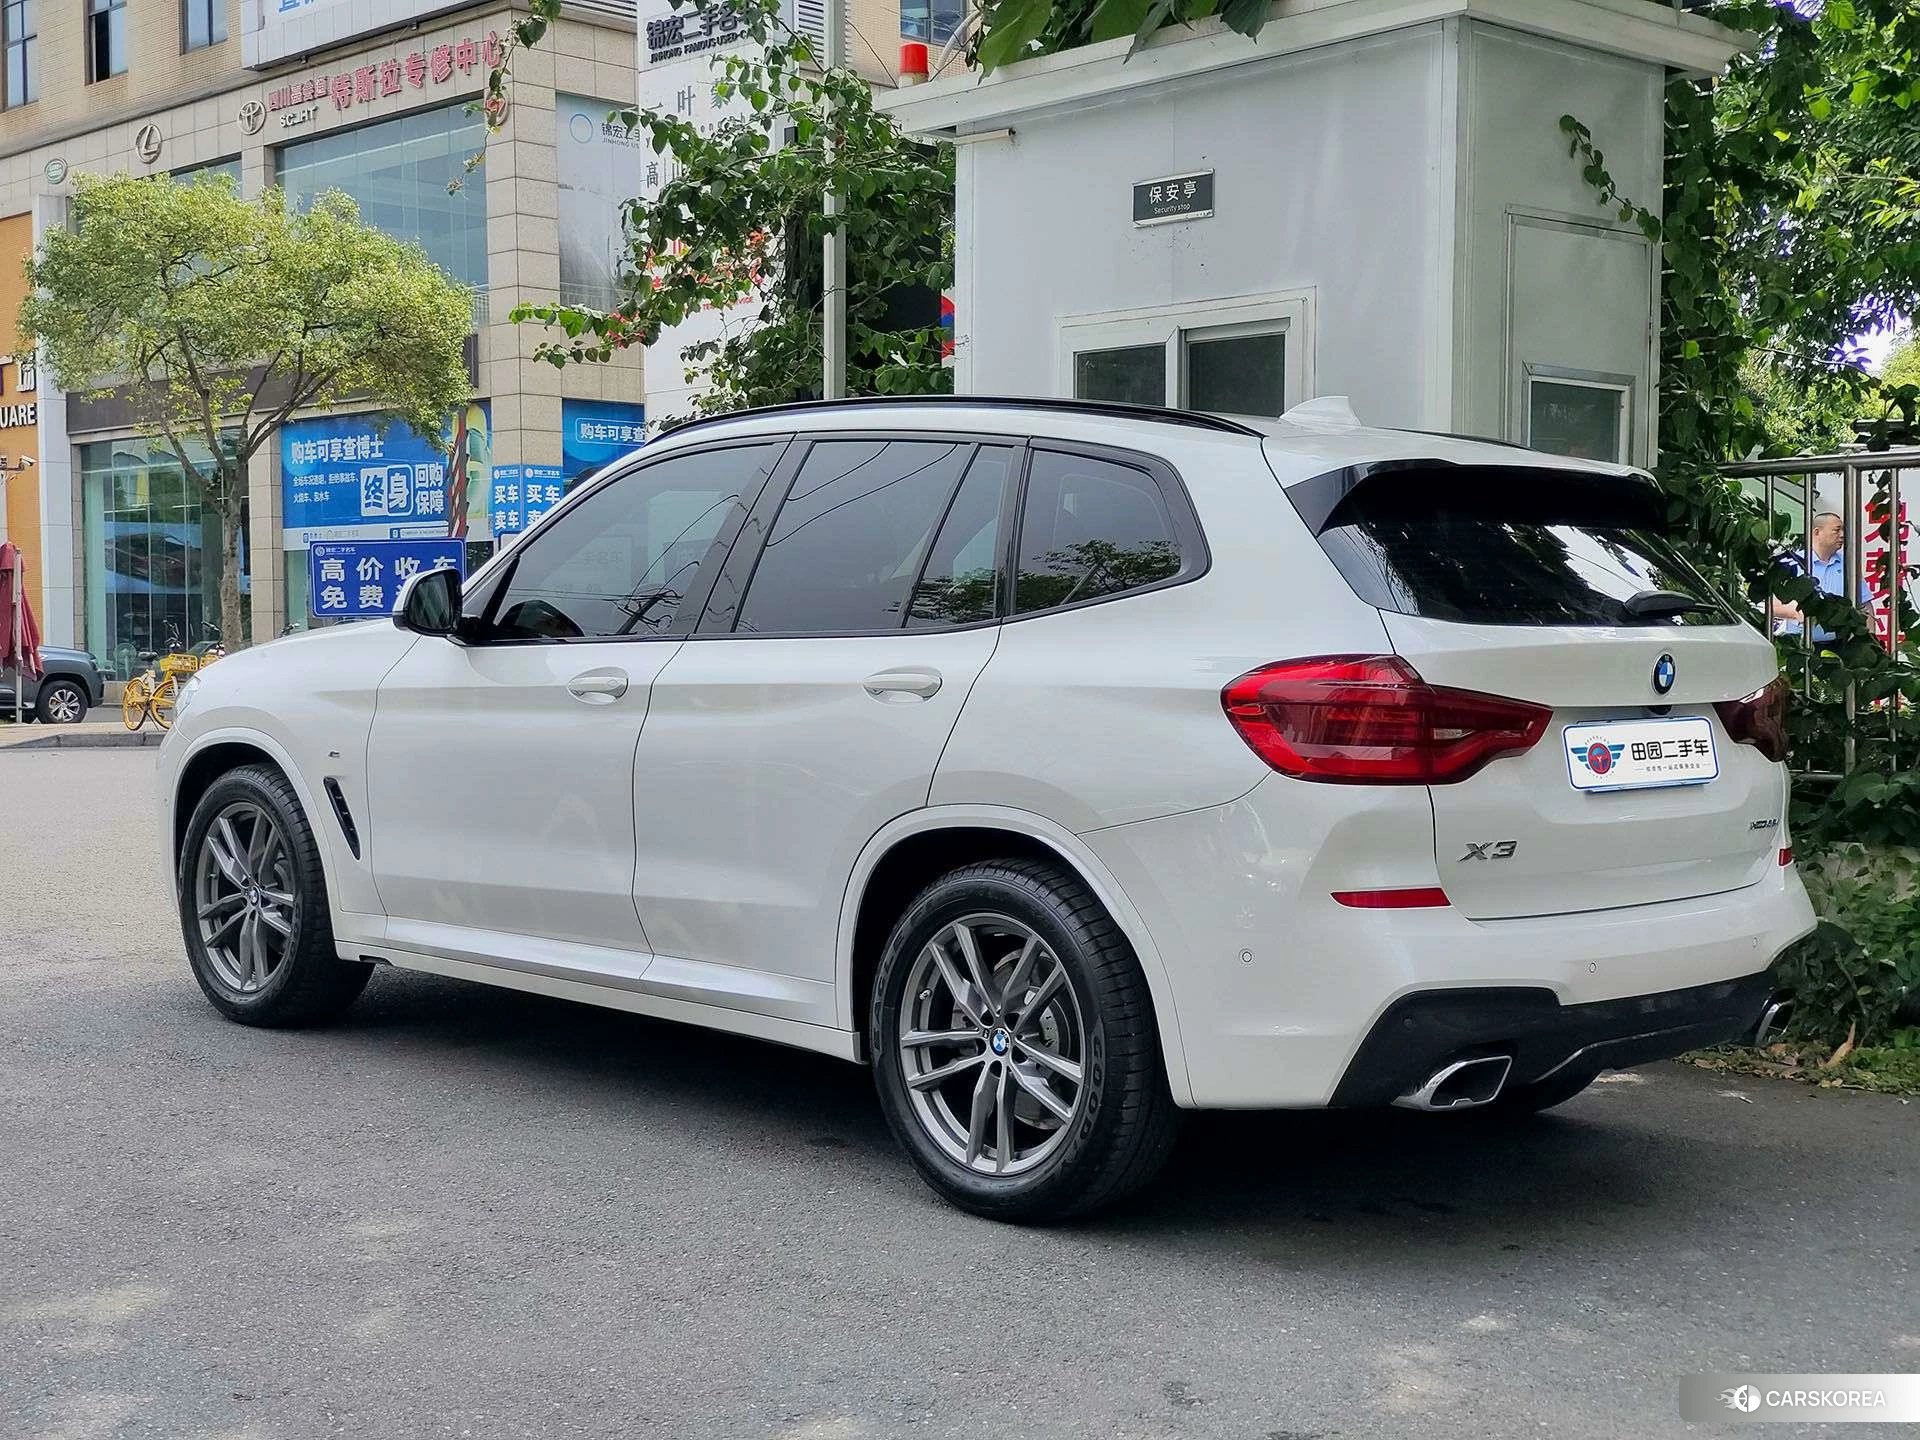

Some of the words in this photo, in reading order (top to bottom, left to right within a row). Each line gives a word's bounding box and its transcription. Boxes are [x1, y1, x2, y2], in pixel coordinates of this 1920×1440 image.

[646, 1, 745, 50] 锦宏二手名
[330, 31, 504, 110] 特斯拉专修中心
[1149, 180, 1197, 204] 保安亭
[580, 423, 646, 442] 购车可享查
[291, 434, 384, 465] 购车可享查博士
[415, 462, 444, 487] 回购
[364, 472, 409, 510] 终身
[415, 488, 445, 515] 保障
[494, 483, 519, 505] 买车
[526, 484, 561, 505] 买车
[494, 509, 520, 531] 卖车
[1631, 738, 1709, 761] 田园二手车
[1458, 839, 1519, 863] X3
